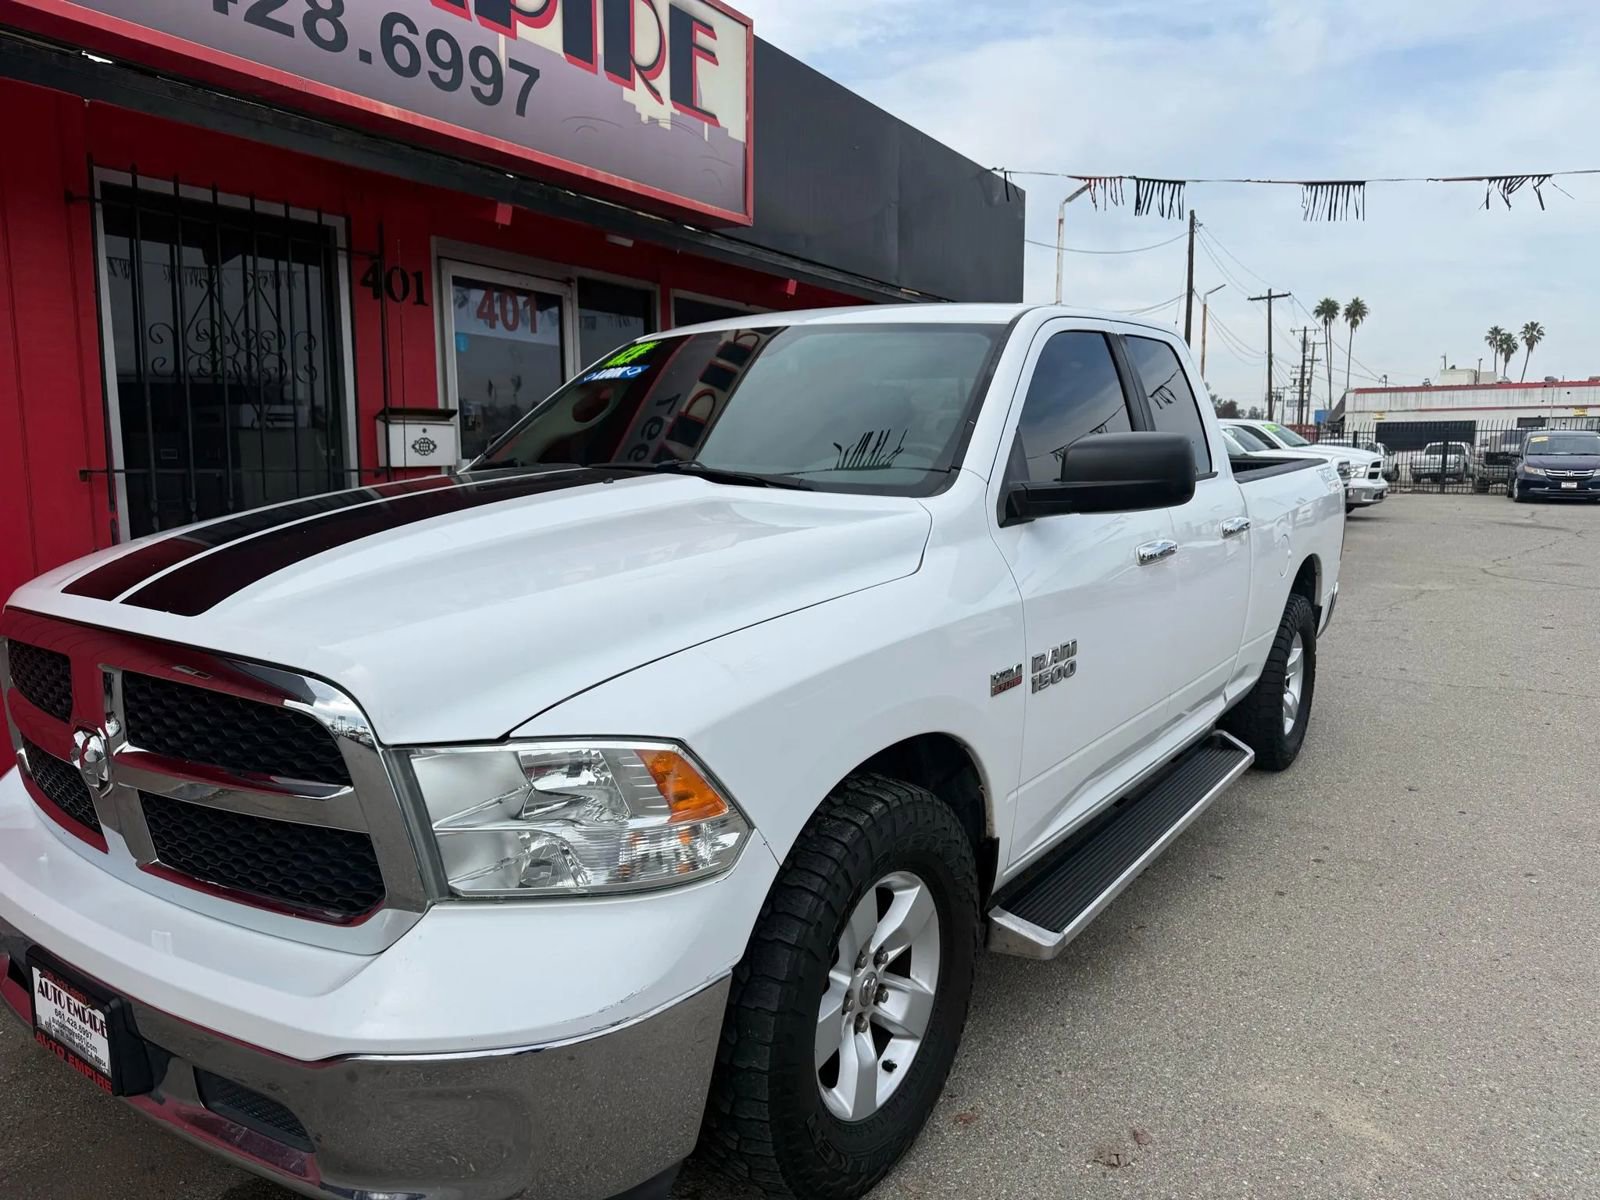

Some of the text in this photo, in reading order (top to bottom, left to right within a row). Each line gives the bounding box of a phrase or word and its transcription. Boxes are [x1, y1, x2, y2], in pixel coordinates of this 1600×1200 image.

[213, 0, 540, 117] 28.6997
[360, 261, 429, 306] 401
[476, 287, 538, 333] 401
[1031, 639, 1077, 674] RAM
[1031, 659, 1077, 694] 1500
[38, 979, 65, 1009] AUTO
[66, 996, 108, 1039] EMPIRE
[36, 1030, 65, 1059] AUTO
[68, 1054, 112, 1093] EMPIRE
